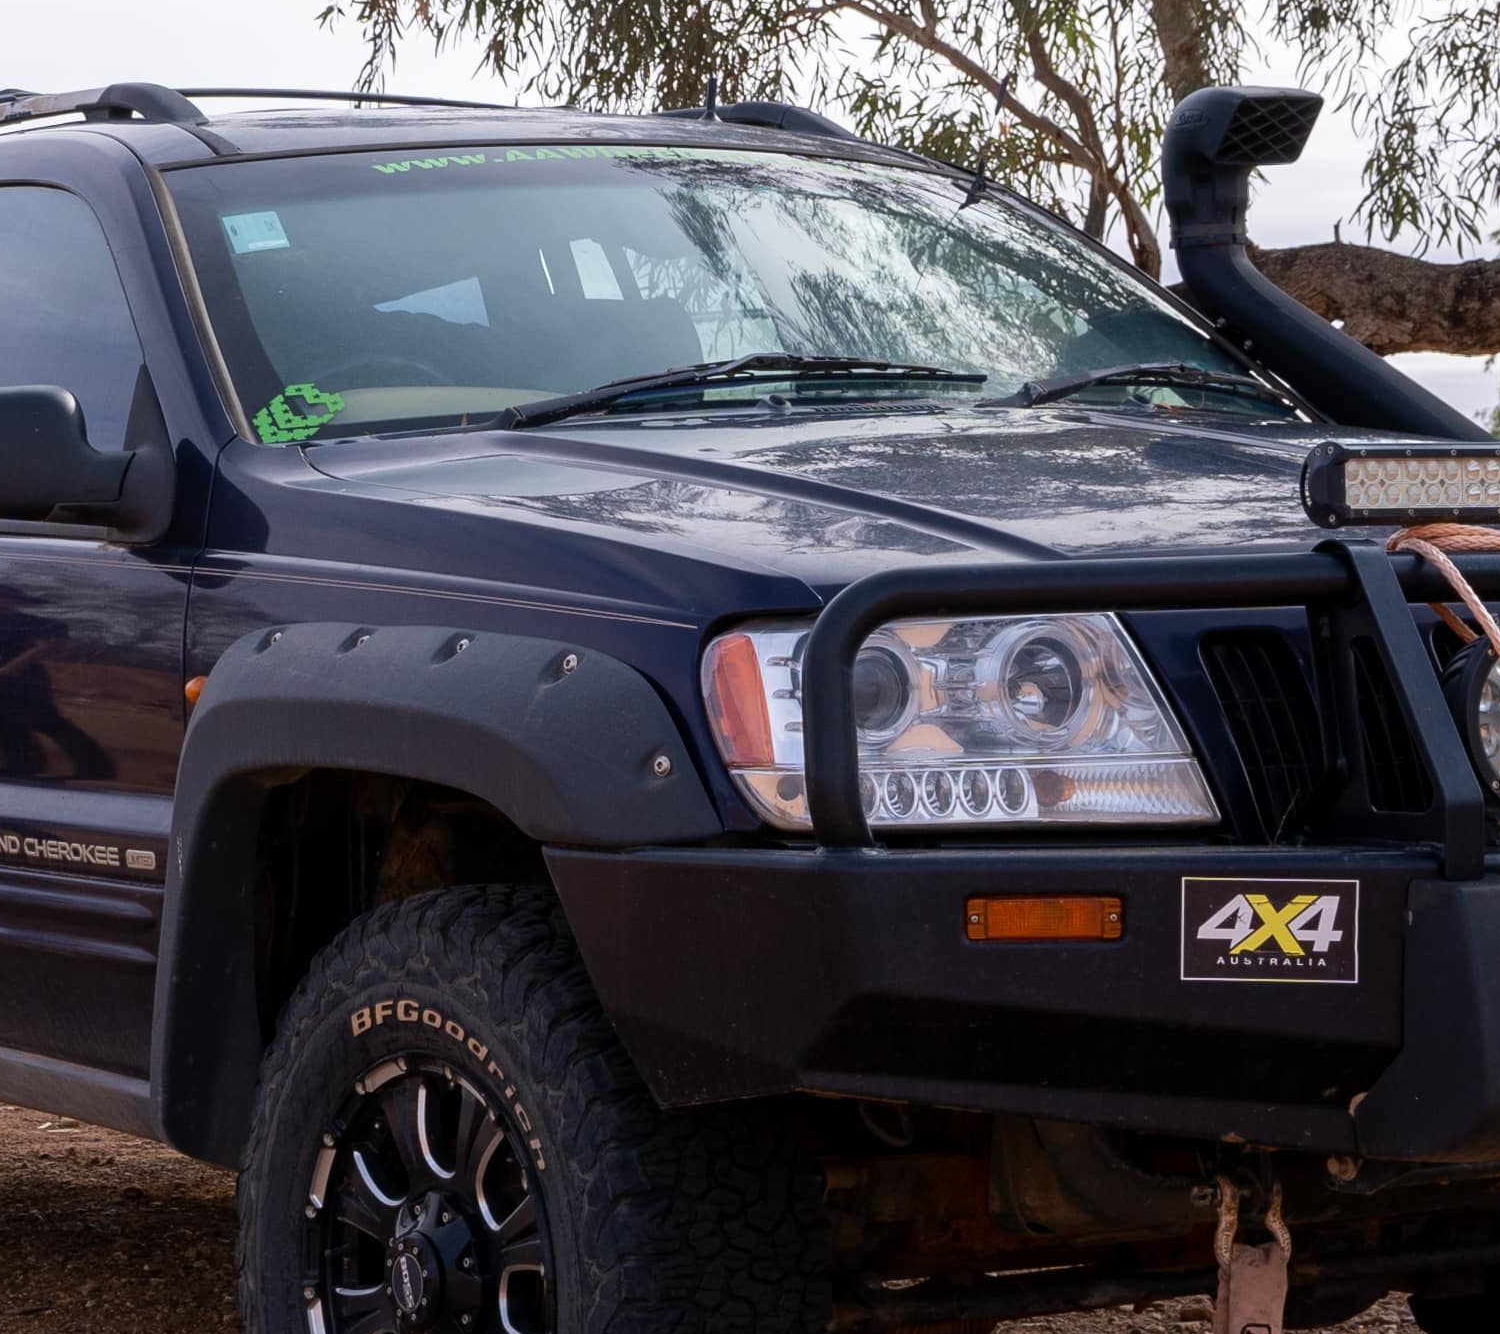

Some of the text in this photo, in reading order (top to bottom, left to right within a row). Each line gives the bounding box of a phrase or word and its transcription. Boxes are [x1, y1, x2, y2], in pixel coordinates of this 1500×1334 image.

[24, 838, 120, 867] CHEROKEE
[1197, 894, 1343, 955] 4X4
[1216, 956, 1328, 967] AUSTRALIA
[351, 999, 546, 1170] BFGoodrich
